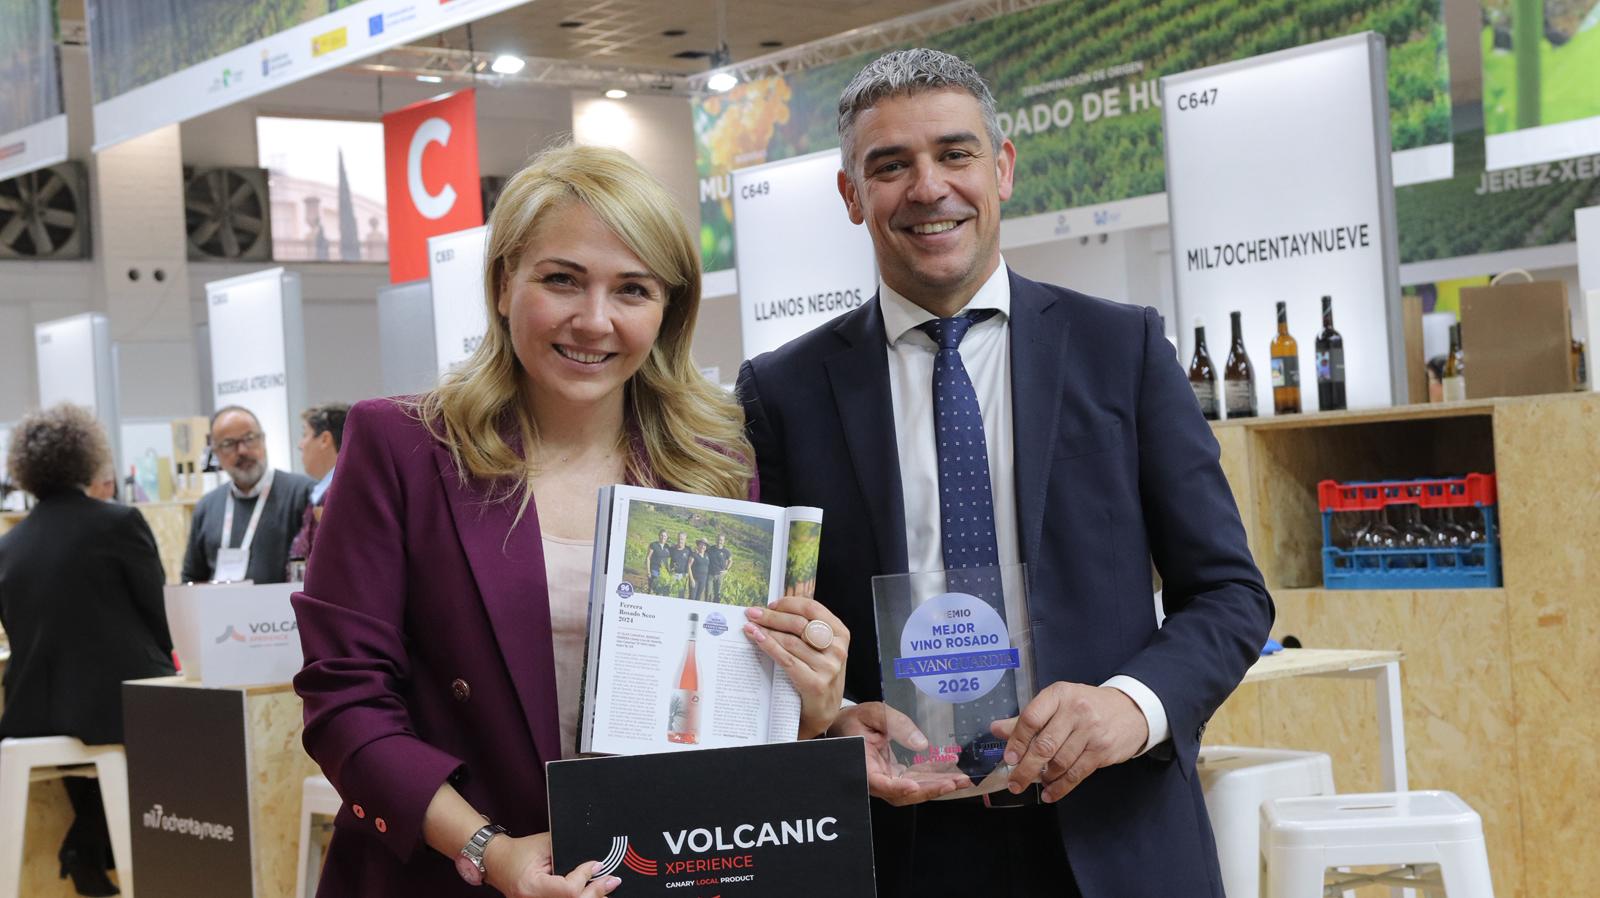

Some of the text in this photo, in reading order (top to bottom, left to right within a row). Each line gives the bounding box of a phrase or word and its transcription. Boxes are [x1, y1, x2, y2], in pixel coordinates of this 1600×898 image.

[1082, 87, 1121, 122] DE
[1178, 88, 1218, 111] C647
[406, 116, 457, 220] C
[741, 181, 770, 200] C649
[1187, 223, 1370, 271] MIL7OCHENTAYNUEVE
[755, 288, 862, 322] LLANOS NEGROS
[932, 622, 975, 636] MEJOR
[910, 633, 999, 652] VINO ROSADO
[917, 653, 1017, 673] VANGUARDIA
[938, 677, 980, 694] 2026
[662, 815, 839, 855] VOLCANIC
[665, 854, 753, 875] XPERIENCE
[665, 874, 754, 889] CANARY LOCAL PRODUCT
